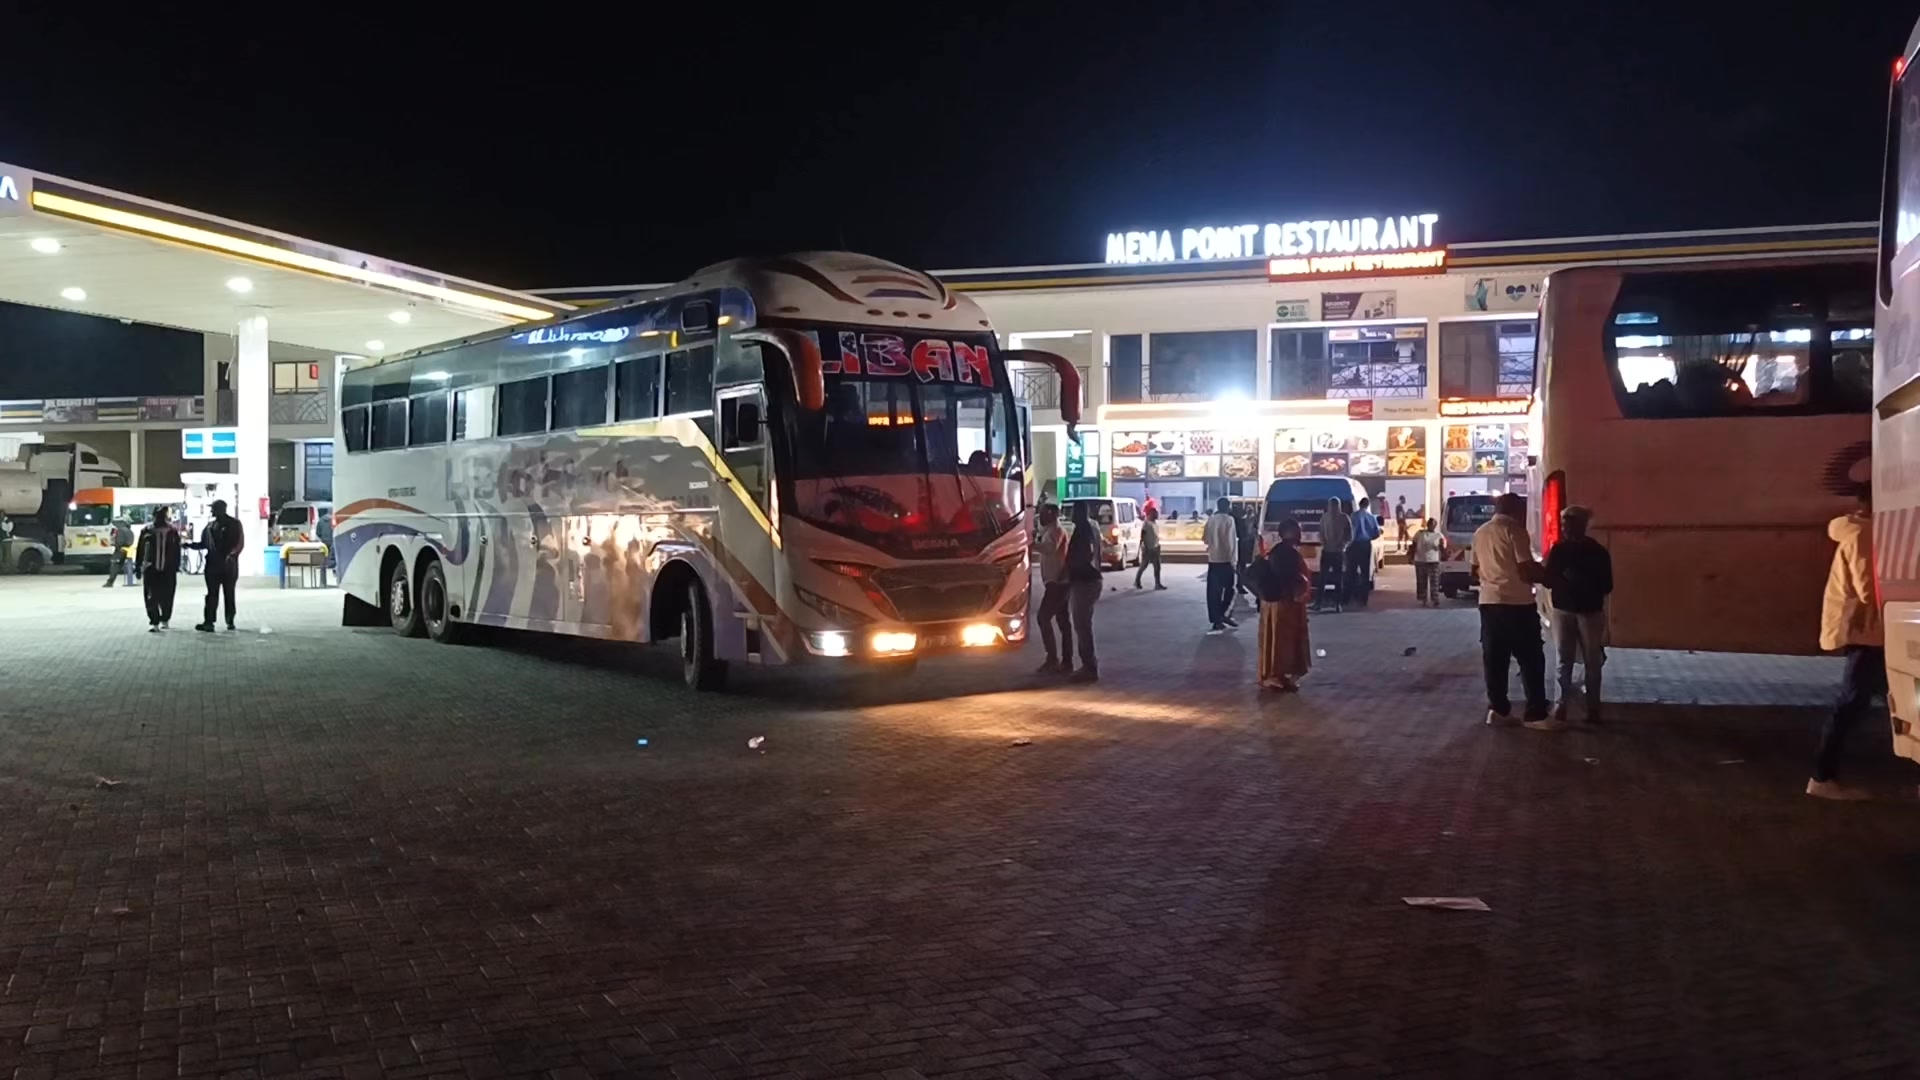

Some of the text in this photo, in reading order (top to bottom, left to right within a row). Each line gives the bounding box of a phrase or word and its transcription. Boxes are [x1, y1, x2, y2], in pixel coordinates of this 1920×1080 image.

[1105, 213, 1439, 264] MENA POINT RESTAURANT
